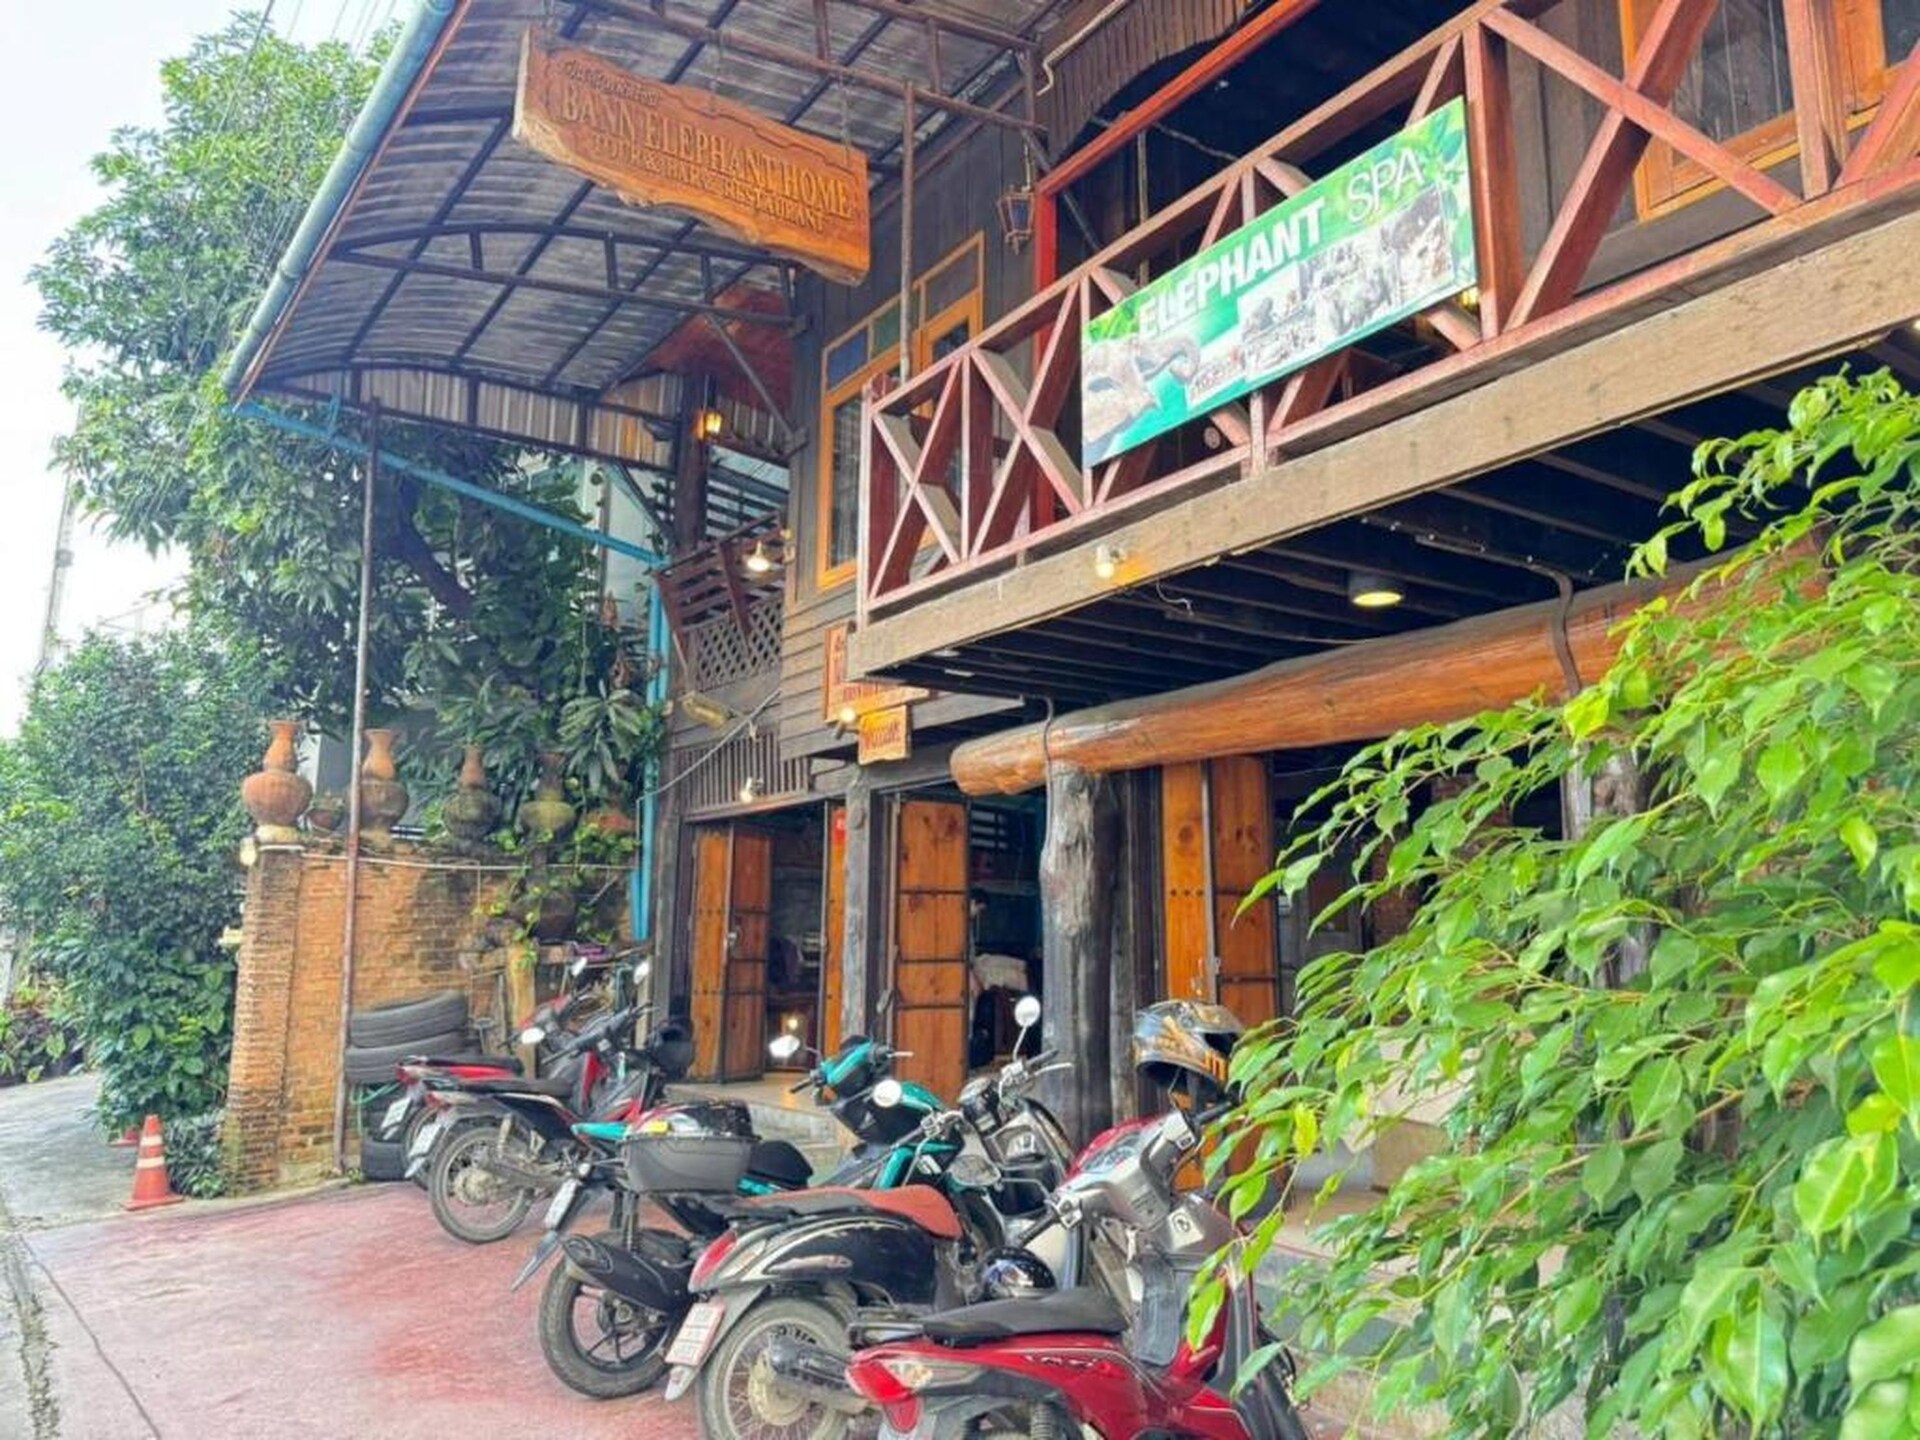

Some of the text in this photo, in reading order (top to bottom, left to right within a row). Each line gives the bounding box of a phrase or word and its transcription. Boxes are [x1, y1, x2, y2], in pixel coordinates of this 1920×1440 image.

[644, 110, 777, 188] ELEPHANT
[780, 160, 854, 218] HOME
[723, 176, 826, 234] RESTAURANT
[1138, 147, 1425, 338] ELEPHANT SPA
